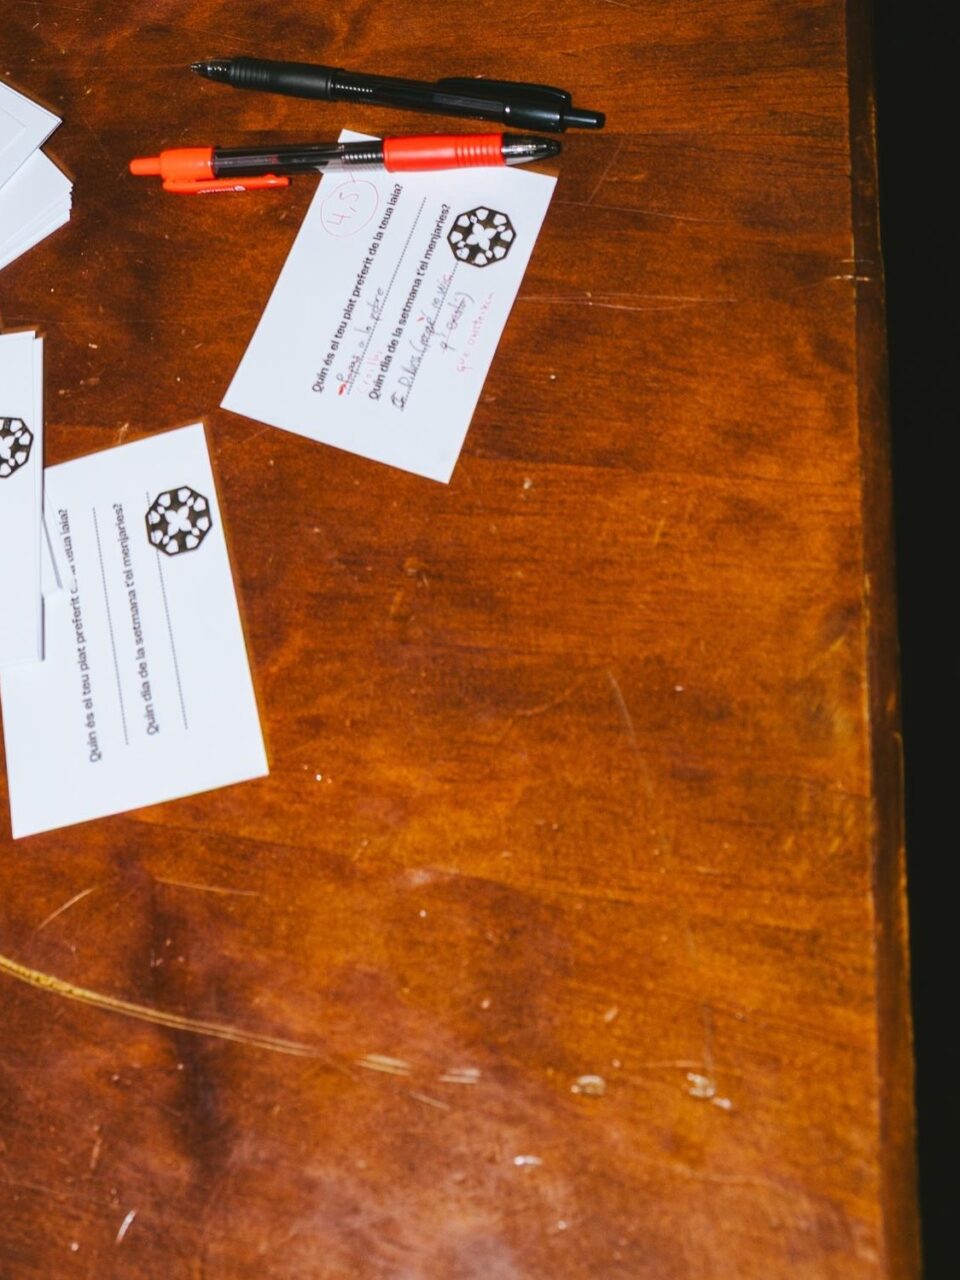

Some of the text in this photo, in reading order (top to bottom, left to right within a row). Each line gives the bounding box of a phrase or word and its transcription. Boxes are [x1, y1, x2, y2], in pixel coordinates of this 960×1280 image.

[424, 203, 449, 259] menjaries?
[416, 260, 428, 276] t'el
[311, 183, 402, 392] Quin és el teu plat preferit de la teua iaia?
[398, 278, 421, 324] setmana
[391, 327, 403, 337] la
[387, 338, 398, 353] de
[379, 354, 392, 372] dia
[368, 374, 385, 399] Quin
[57, 508, 69, 534] iaia?
[70, 596, 85, 643] preferit
[112, 503, 159, 735] Quin dia de la setmana t'el menjaries?
[77, 646, 89, 671] plat
[81, 673, 91, 695] teu
[82, 697, 93, 709] el
[85, 712, 95, 728] és
[87, 730, 101, 762] Quin
